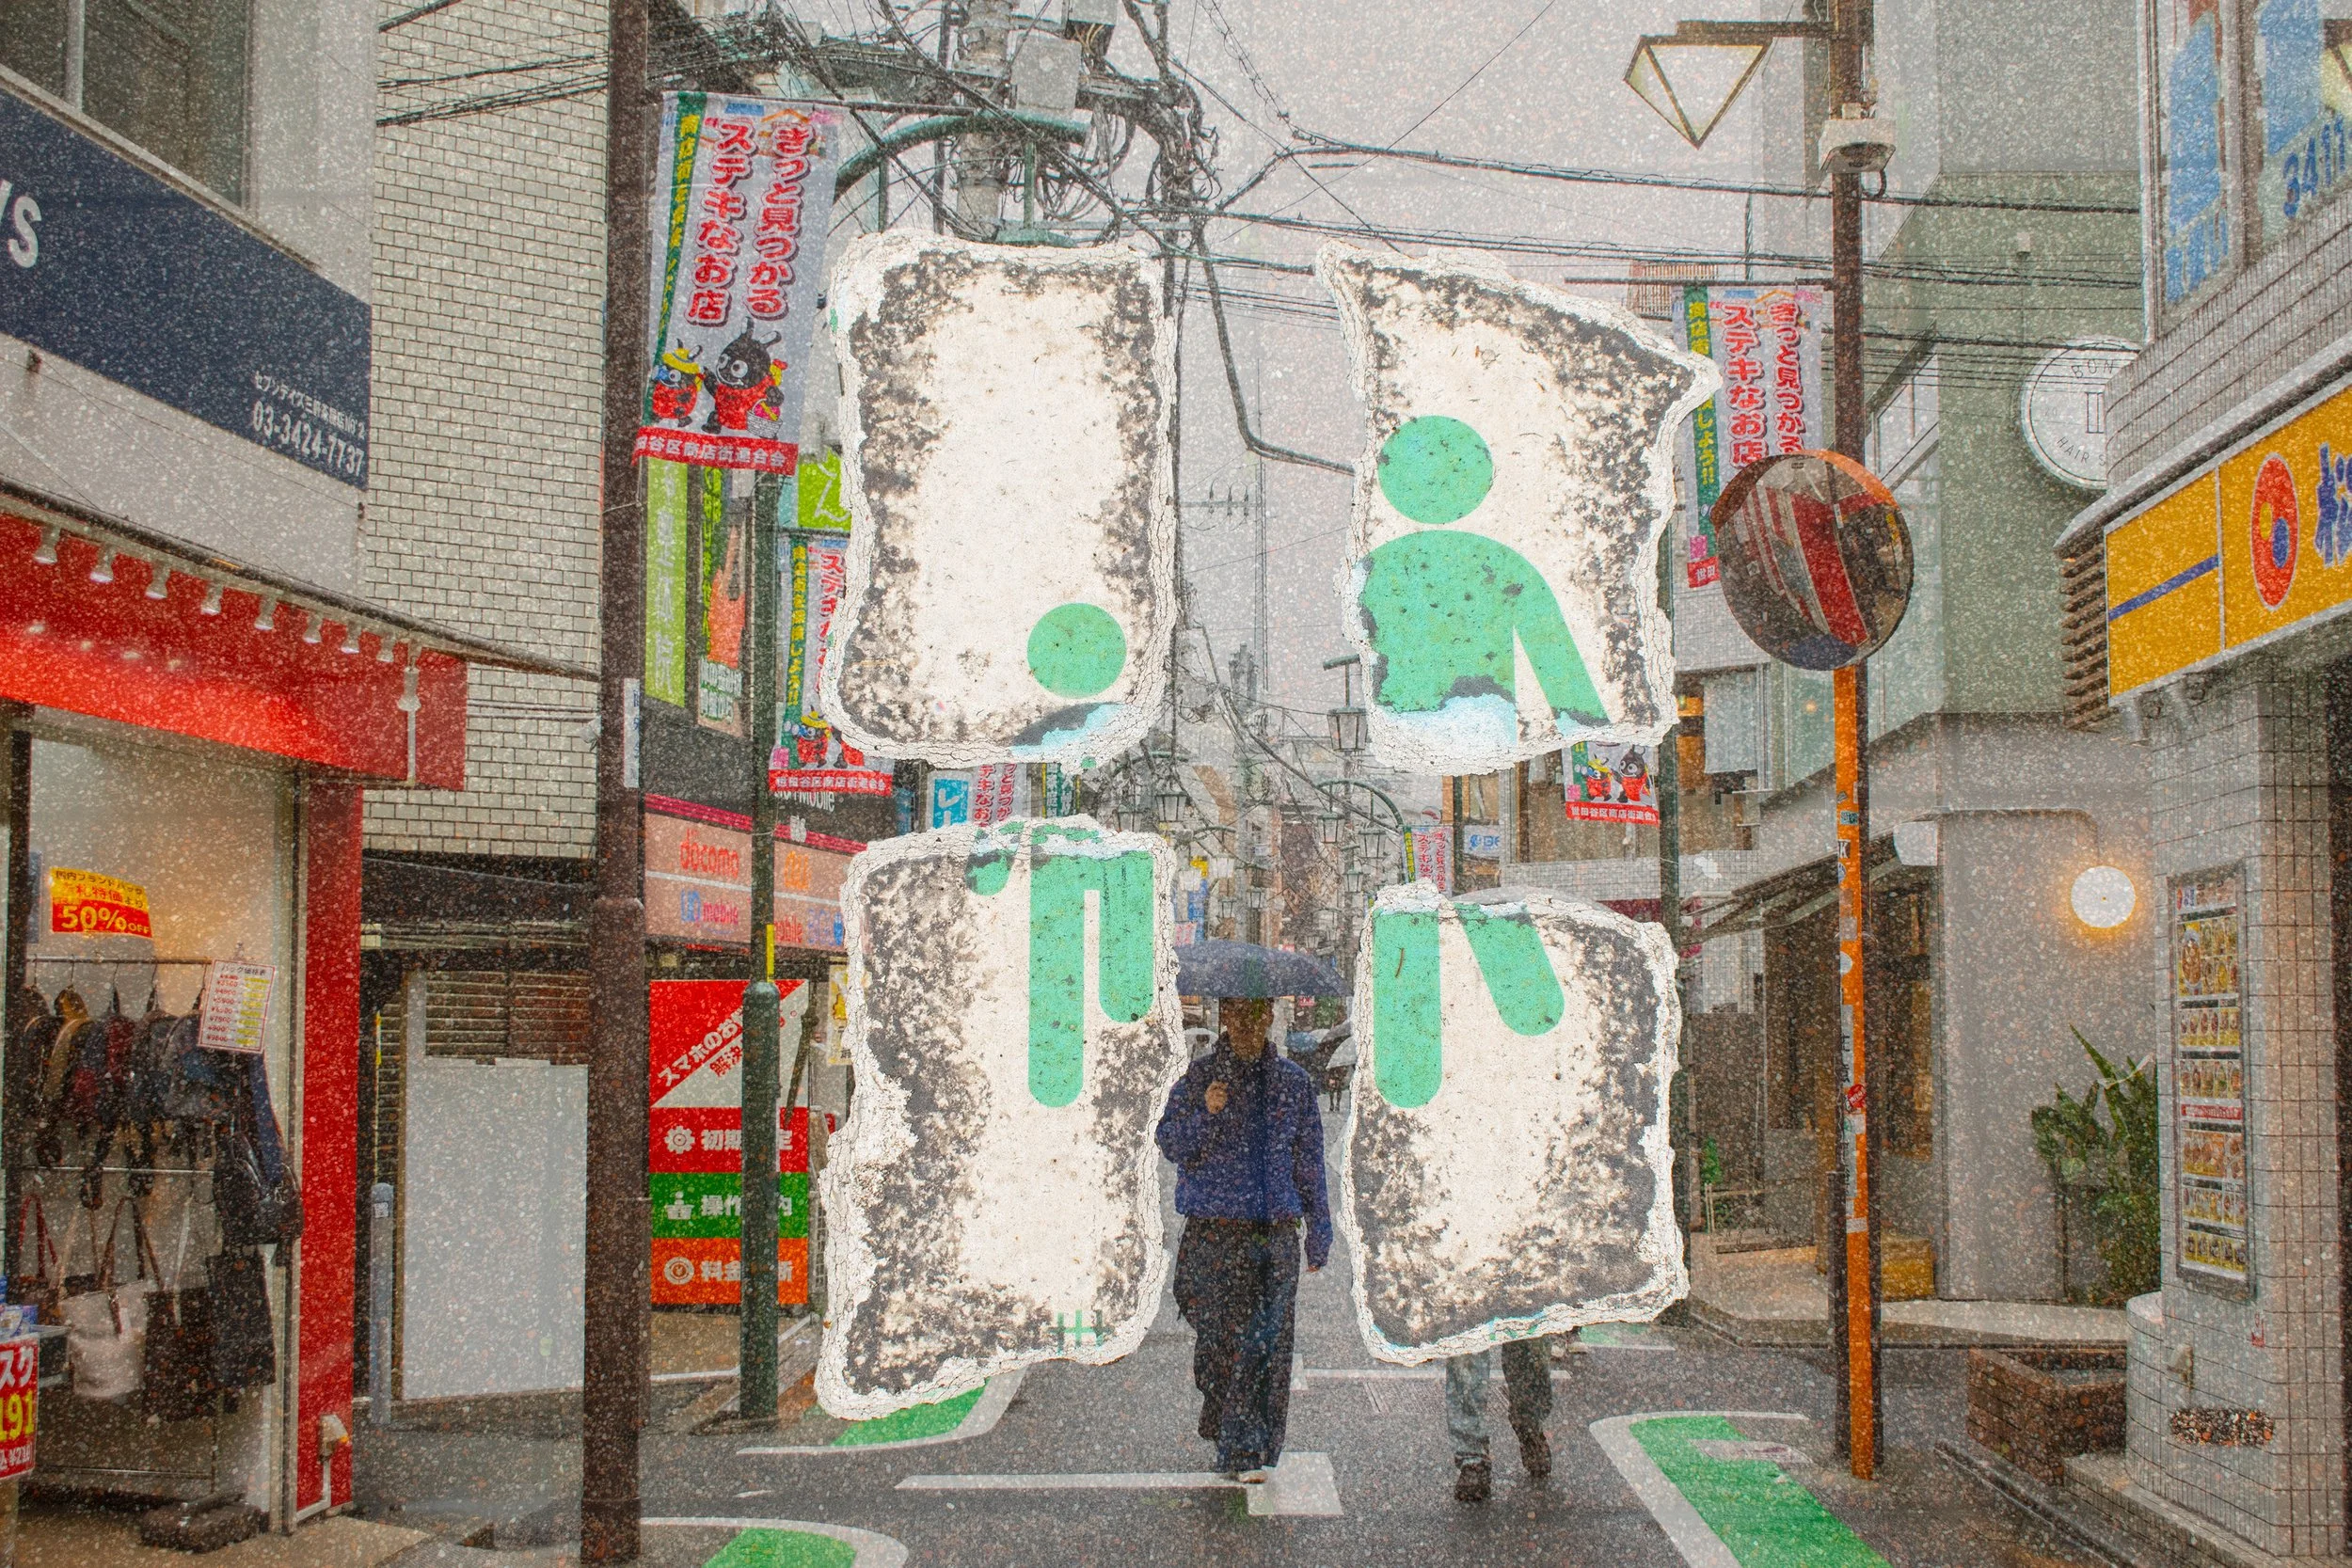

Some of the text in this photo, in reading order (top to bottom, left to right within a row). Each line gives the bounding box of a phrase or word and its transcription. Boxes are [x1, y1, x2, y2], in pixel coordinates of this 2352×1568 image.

[686, 119, 756, 325] ステキなお店
[748, 119, 816, 320] きっと見つかる
[1724, 302, 1768, 467] ステキなお店
[253, 401, 365, 477] 03-3424-7737
[2057, 436, 2090, 463] HAIR
[973, 765, 996, 827] テキなお
[679, 828, 739, 879] docomo
[61, 905, 151, 934] 50% OFF
[703, 899, 739, 926] mobile
[701, 1129, 793, 1152] 初期定
[701, 1195, 792, 1218] 操作内
